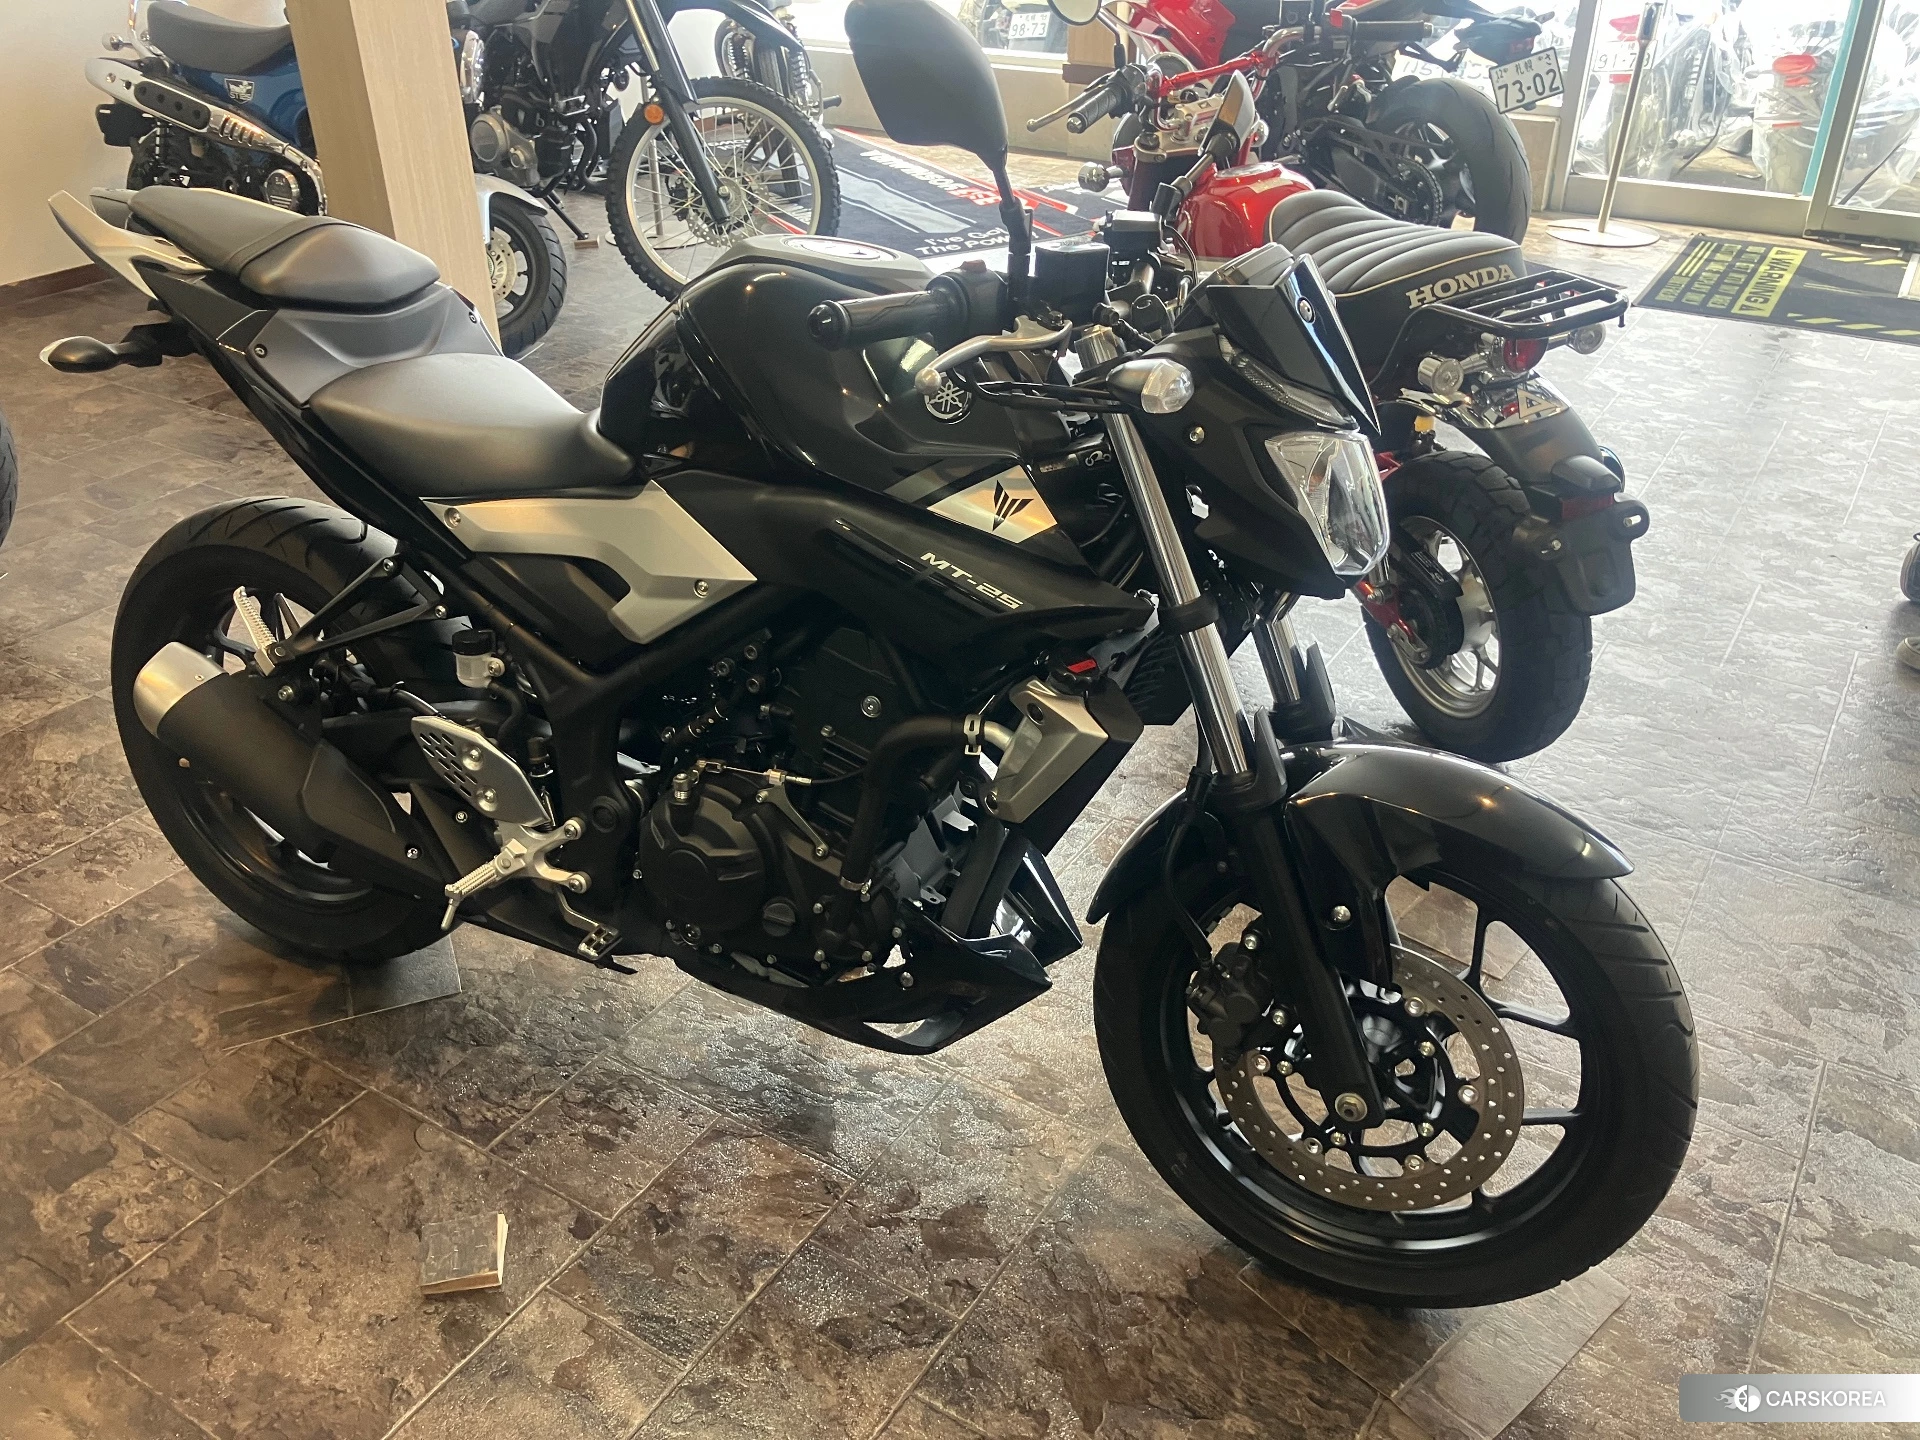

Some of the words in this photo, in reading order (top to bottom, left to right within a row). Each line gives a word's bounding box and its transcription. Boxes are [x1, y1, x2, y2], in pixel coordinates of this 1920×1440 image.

[1011, 23, 1047, 37] 98-73
[1497, 68, 1561, 108] 73-02
[914, 244, 961, 255] The
[924, 236, 964, 246] I've
[1405, 263, 1517, 309] HONDA
[1746, 257, 1794, 304] WARNING
[920, 552, 1024, 610] MT-25
